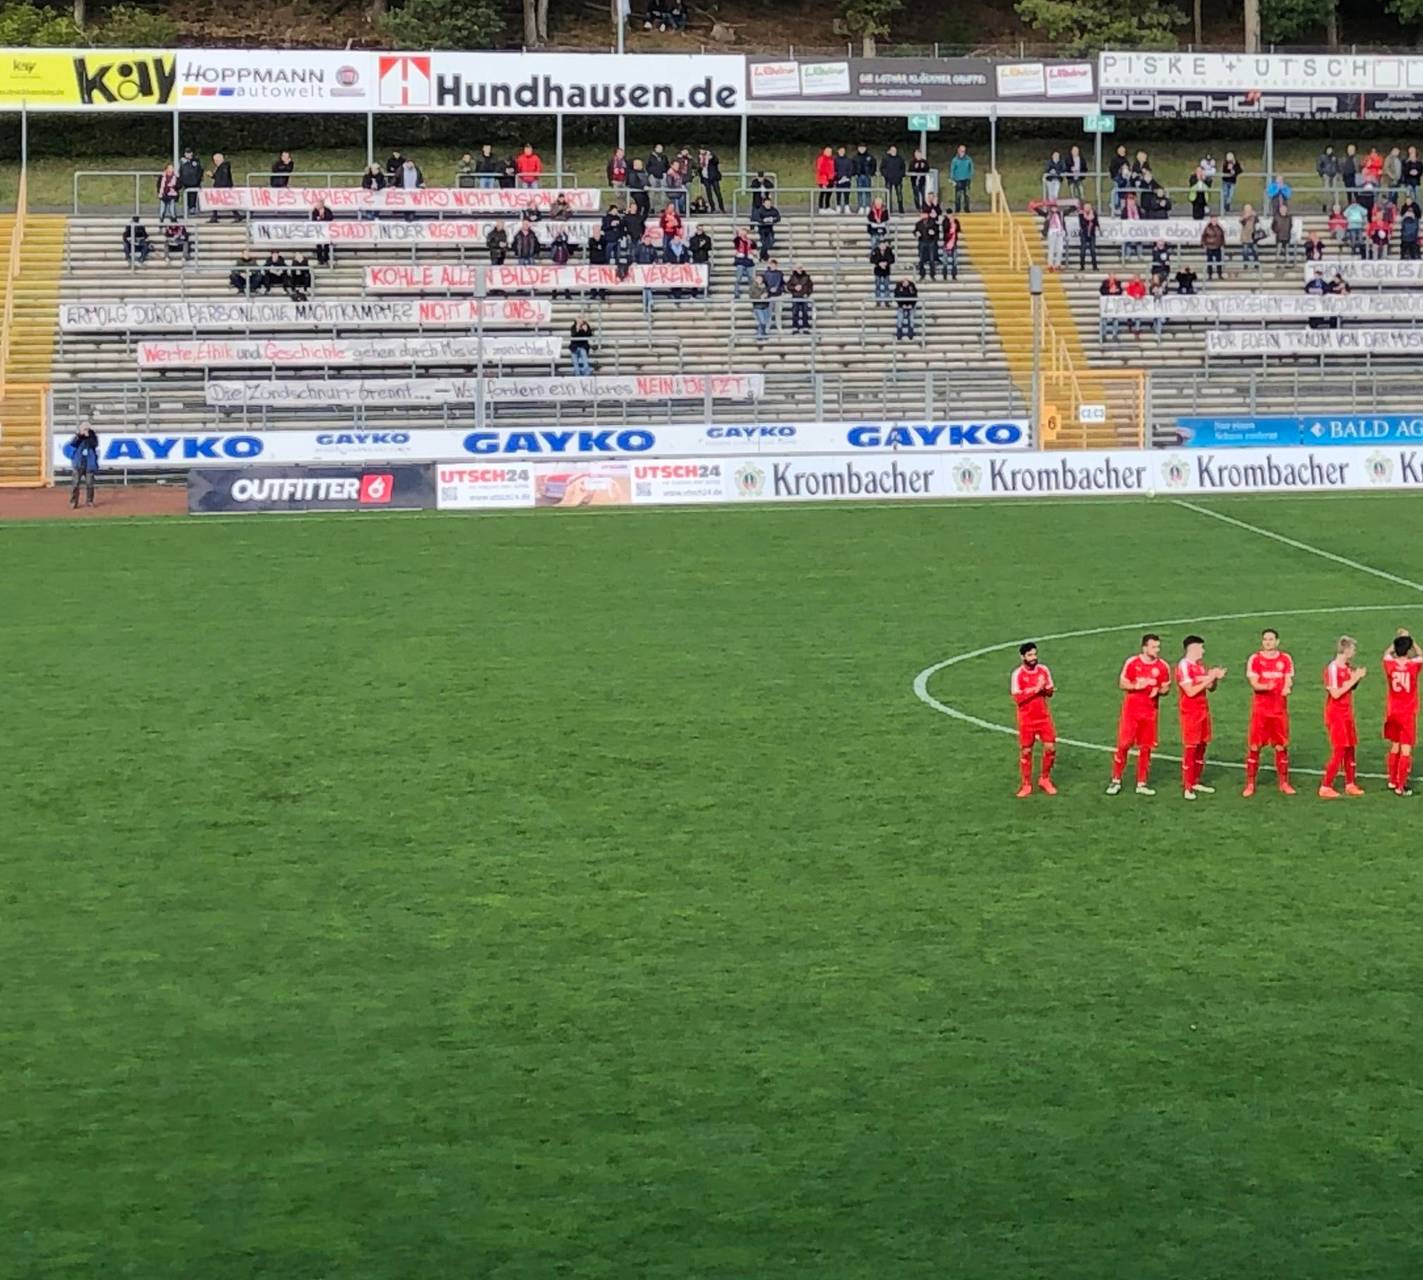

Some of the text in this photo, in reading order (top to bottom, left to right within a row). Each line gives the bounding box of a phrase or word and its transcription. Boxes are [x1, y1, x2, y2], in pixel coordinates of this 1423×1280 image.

[182, 62, 324, 83] HOPPMANN
[1103, 56, 1206, 76] PISKE
[1225, 60, 1236, 73] +
[1254, 57, 1367, 77] UTSCH
[237, 86, 324, 98] autowelt
[436, 73, 738, 109] Hundhausen.de
[1101, 90, 1338, 113] DORNHÖFER
[371, 267, 433, 287] KOHLE
[502, 267, 561, 286] BILDET
[418, 301, 462, 321] NICHT
[236, 345, 261, 360] und
[550, 384, 577, 397] ein
[315, 432, 411, 446] GAYKO
[706, 426, 797, 439] GAYKO
[846, 422, 1023, 447] GAYKO
[1331, 420, 1389, 438] BALD
[462, 429, 656, 455] GAYKO
[440, 468, 530, 484] UTSCH24
[634, 465, 722, 480] UTSCH24
[773, 460, 935, 497] Krombacher
[989, 456, 1147, 493] Krombacher
[1197, 450, 1349, 489] Krombacher
[232, 478, 360, 502] OUTFITTER
[1391, 671, 1411, 694] 24
